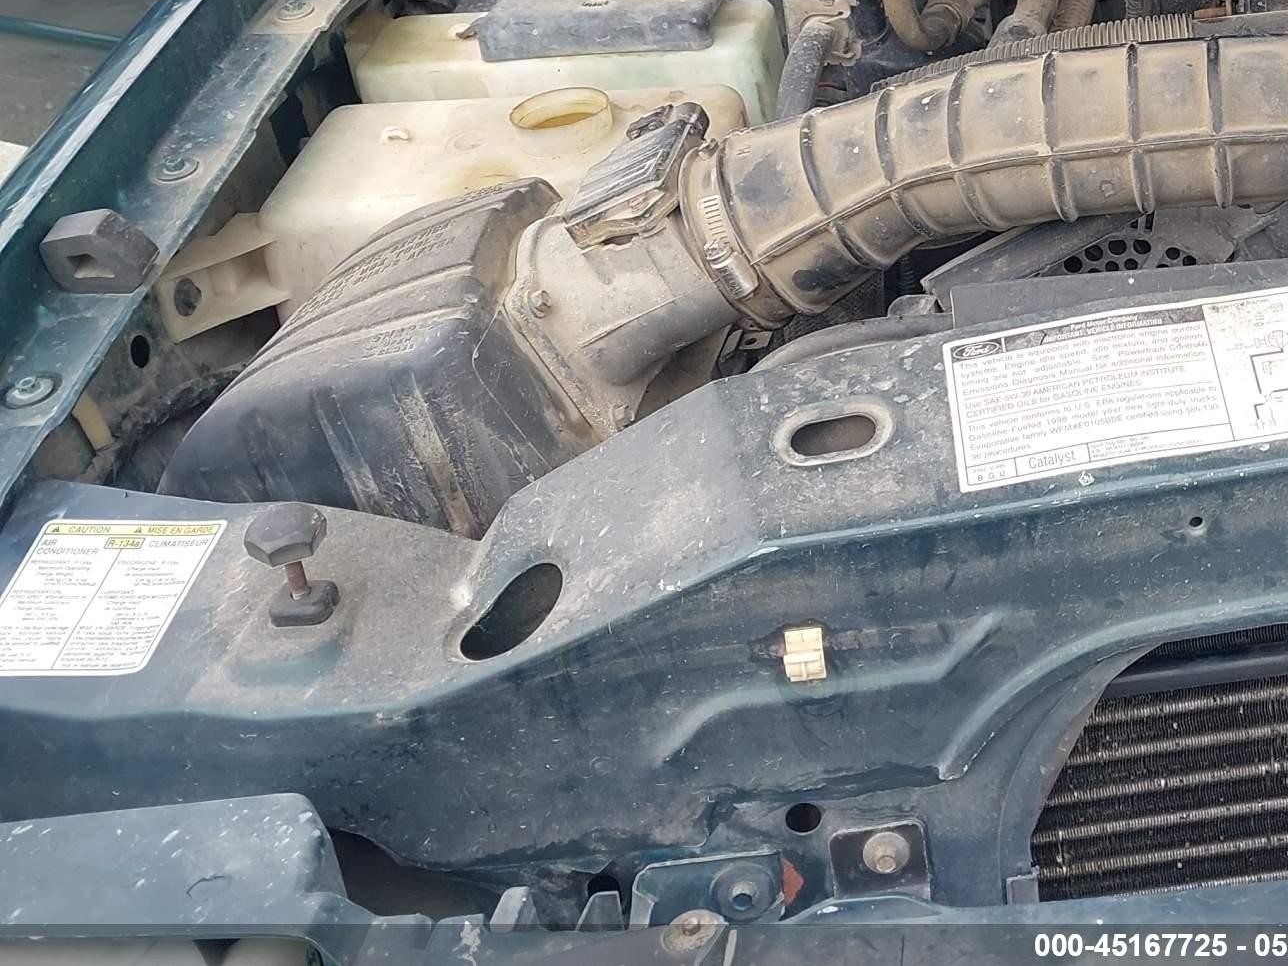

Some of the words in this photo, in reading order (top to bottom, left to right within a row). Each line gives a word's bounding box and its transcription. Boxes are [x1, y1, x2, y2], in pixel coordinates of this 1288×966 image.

[1115, 318, 1163, 329] INFORMATION
[959, 361, 977, 369] This
[1032, 381, 1080, 394] AMERICAN
[1081, 370, 1138, 385] PETROLEUM
[1139, 365, 1186, 376] INSTITUTE
[965, 403, 1014, 418] CERTIFIED
[1052, 386, 1099, 400] GASOLINE
[1027, 450, 1076, 470] Catalyst
[68, 525, 112, 534] CAUTION
[147, 526, 168, 534] MISE
[170, 526, 181, 534] EN
[182, 526, 215, 536] GARDE
[41, 538, 58, 547] AIR
[108, 538, 141, 548] R-134a
[148, 538, 210, 548] CLIMATISEUR
[36, 547, 99, 556] CONDITIONER
